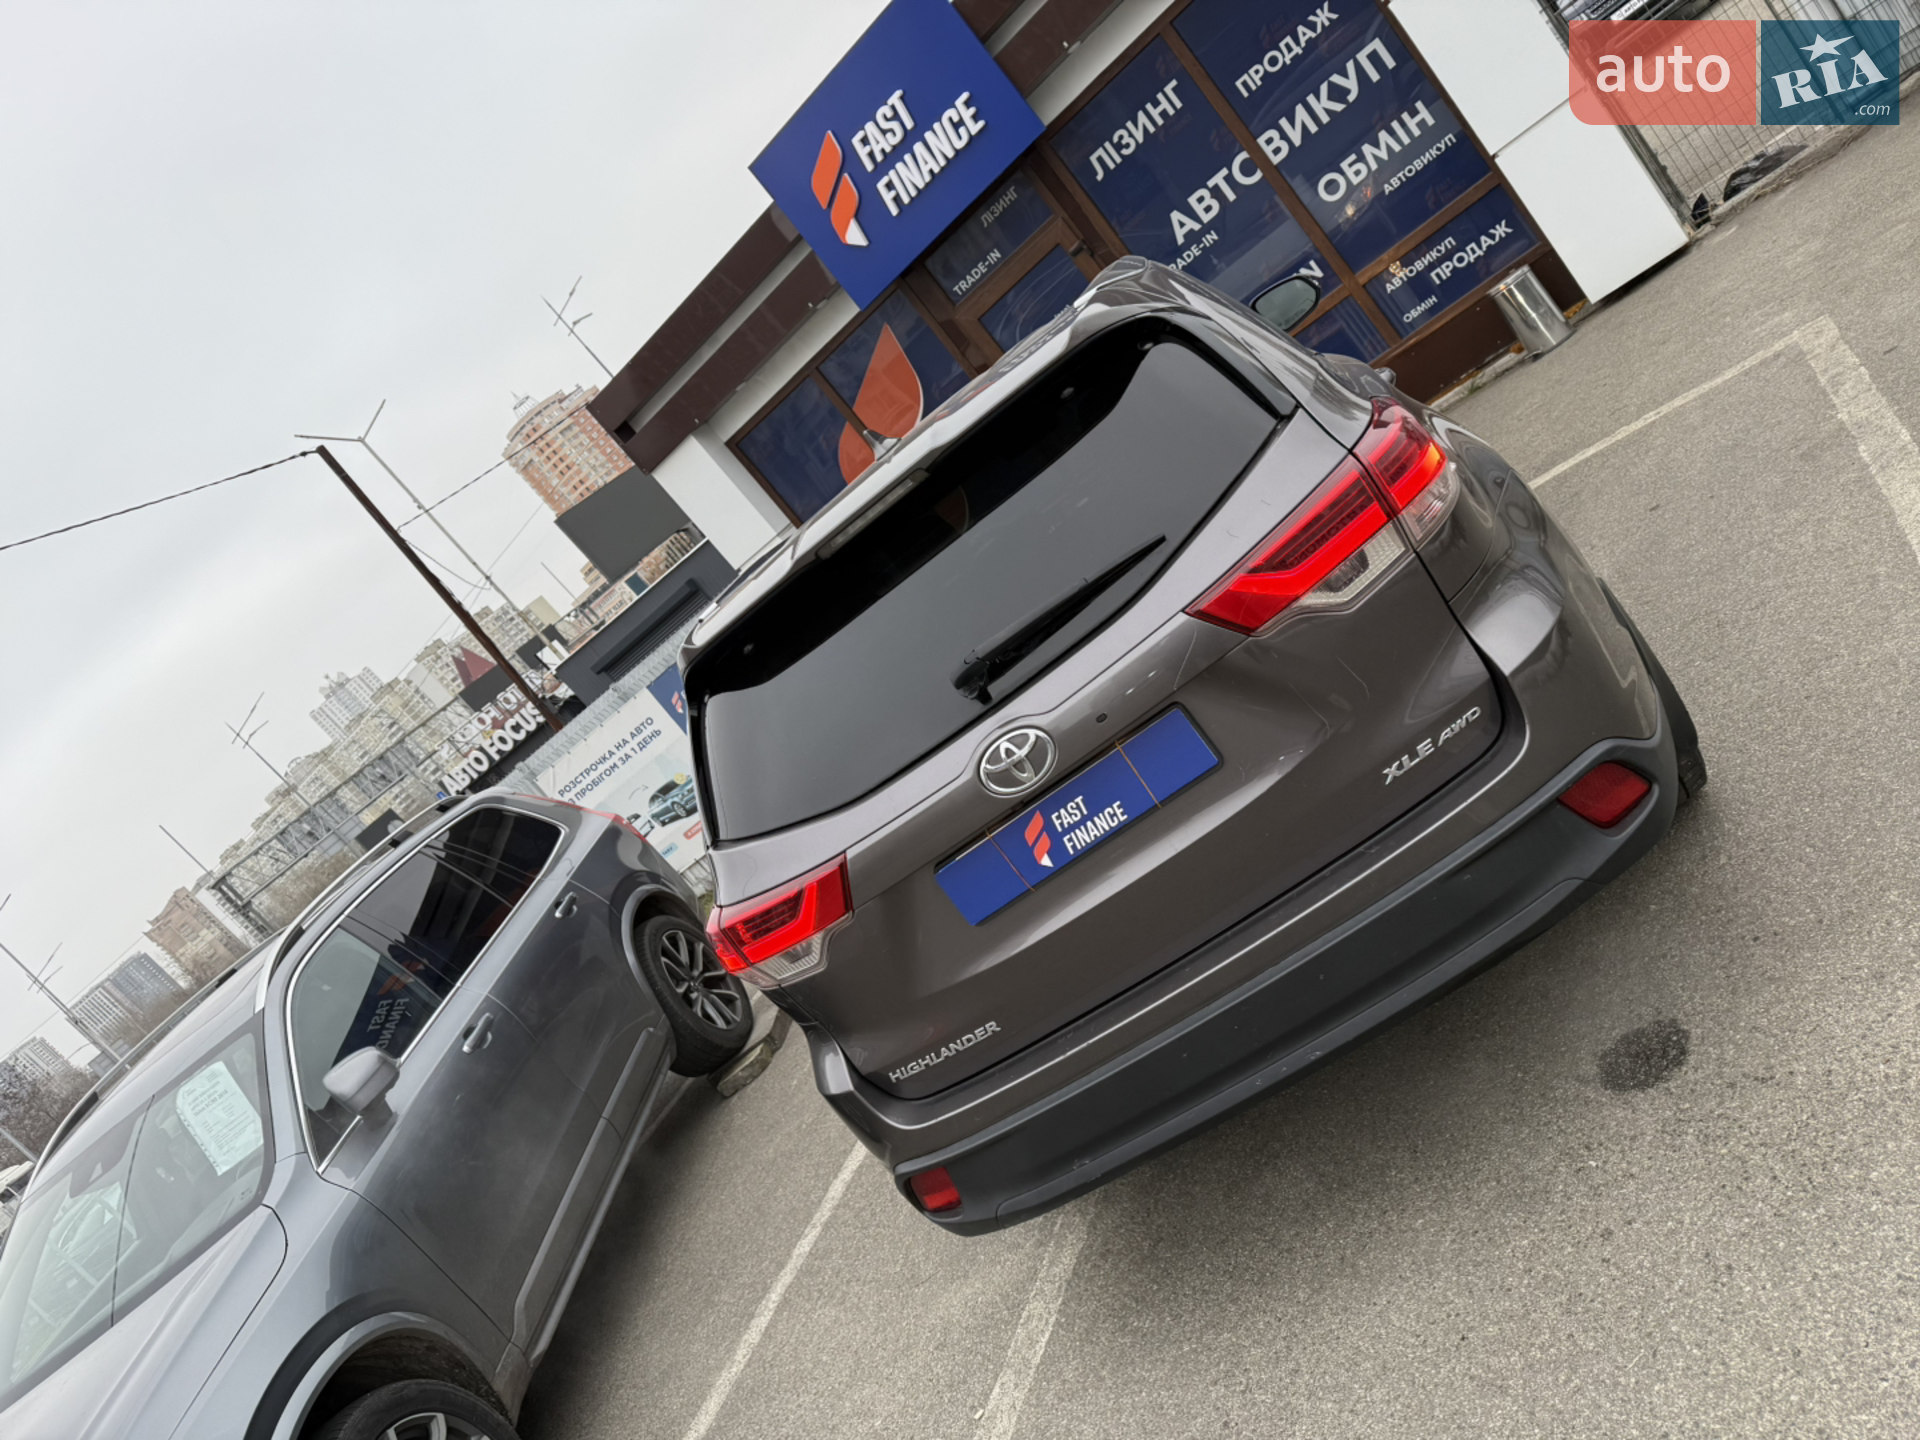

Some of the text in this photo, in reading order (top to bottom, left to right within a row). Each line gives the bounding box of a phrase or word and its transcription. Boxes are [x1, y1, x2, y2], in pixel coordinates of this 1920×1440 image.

[1234, 1, 1339, 98] ПРОДАЖ
[851, 89, 915, 173] FAST
[876, 91, 986, 217] FINANCE
[1088, 79, 1184, 182] ЛІЗИНГ
[1169, 37, 1397, 246] АВТОВИКУП
[1317, 100, 1436, 203] ОБМІН
[1382, 133, 1457, 195] АВТОВИКУП
[980, 186, 1019, 228] ЛІЗИНГ
[953, 248, 1002, 297] TRADE-IN
[1168, 230, 1219, 273] RADE-IN
[1385, 237, 1456, 294] АВТОВИКУП
[1429, 219, 1513, 286] ПРОДАЖ
[1403, 295, 1439, 323] ОБМІН
[440, 700, 546, 797] АВТО FOCUS
[558, 716, 655, 798] РОЗСТРОЧКА НА АВТО
[575, 760, 621, 804] ПРОБІГОМ
[619, 752, 633, 767] ЗА
[630, 746, 638, 757] 1
[637, 727, 663, 756] ДЕНЬ
[1382, 706, 1481, 785] XLE AWD
[1051, 795, 1088, 832] FAST
[1063, 801, 1128, 855] FINANCE
[888, 1020, 1001, 1083] HIGHLANDER
